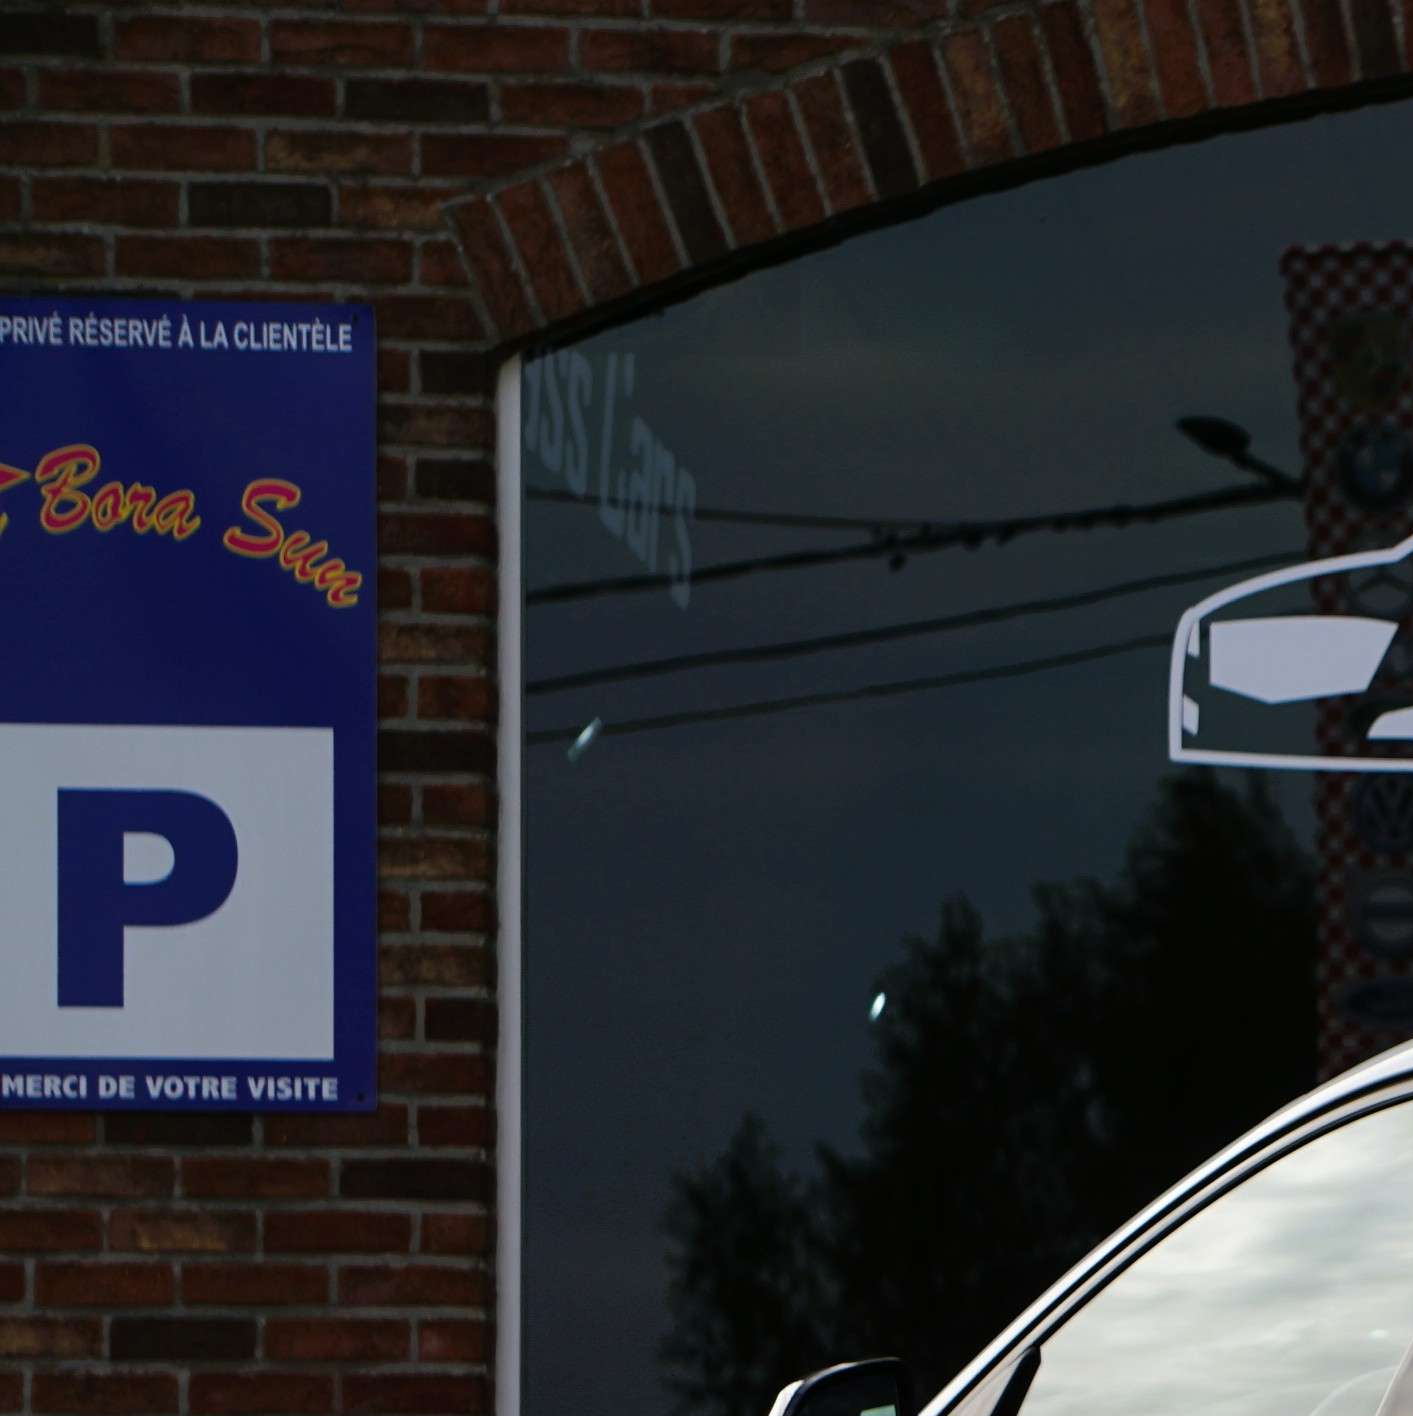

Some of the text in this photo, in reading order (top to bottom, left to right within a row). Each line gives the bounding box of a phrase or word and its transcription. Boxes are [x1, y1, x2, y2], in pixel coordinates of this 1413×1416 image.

[0, 311, 353, 352] PRIVÉ RÉSERVÉ À LA CLIENTÈLE
[34, 443, 363, 609] Bora Sun
[57, 788, 238, 1008] P
[1, 1074, 339, 1101] MERCI DE VOTRE VISITE
